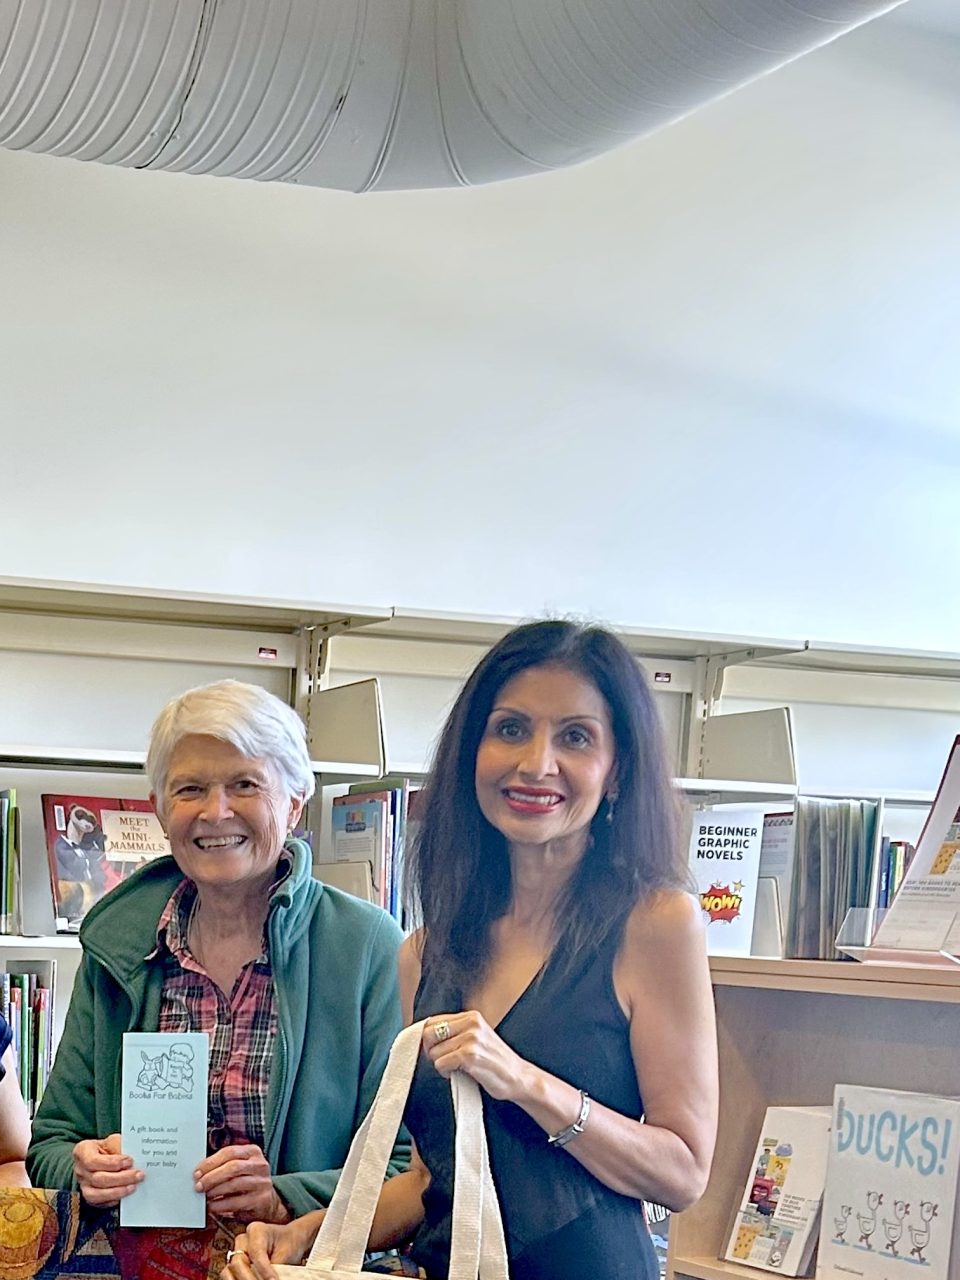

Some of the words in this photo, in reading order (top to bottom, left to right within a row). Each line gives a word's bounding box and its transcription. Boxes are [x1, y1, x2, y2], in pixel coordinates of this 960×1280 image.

[120, 816, 149, 827] MEET
[699, 825, 758, 837] BEGINNER
[110, 840, 165, 852] MAMMALS
[697, 837, 750, 849] GRAPHIC
[696, 849, 744, 860] NOVELS
[699, 894, 741, 912] WOW!
[153, 1092, 166, 1100] For
[837, 1109, 953, 1177] DUCKS!
